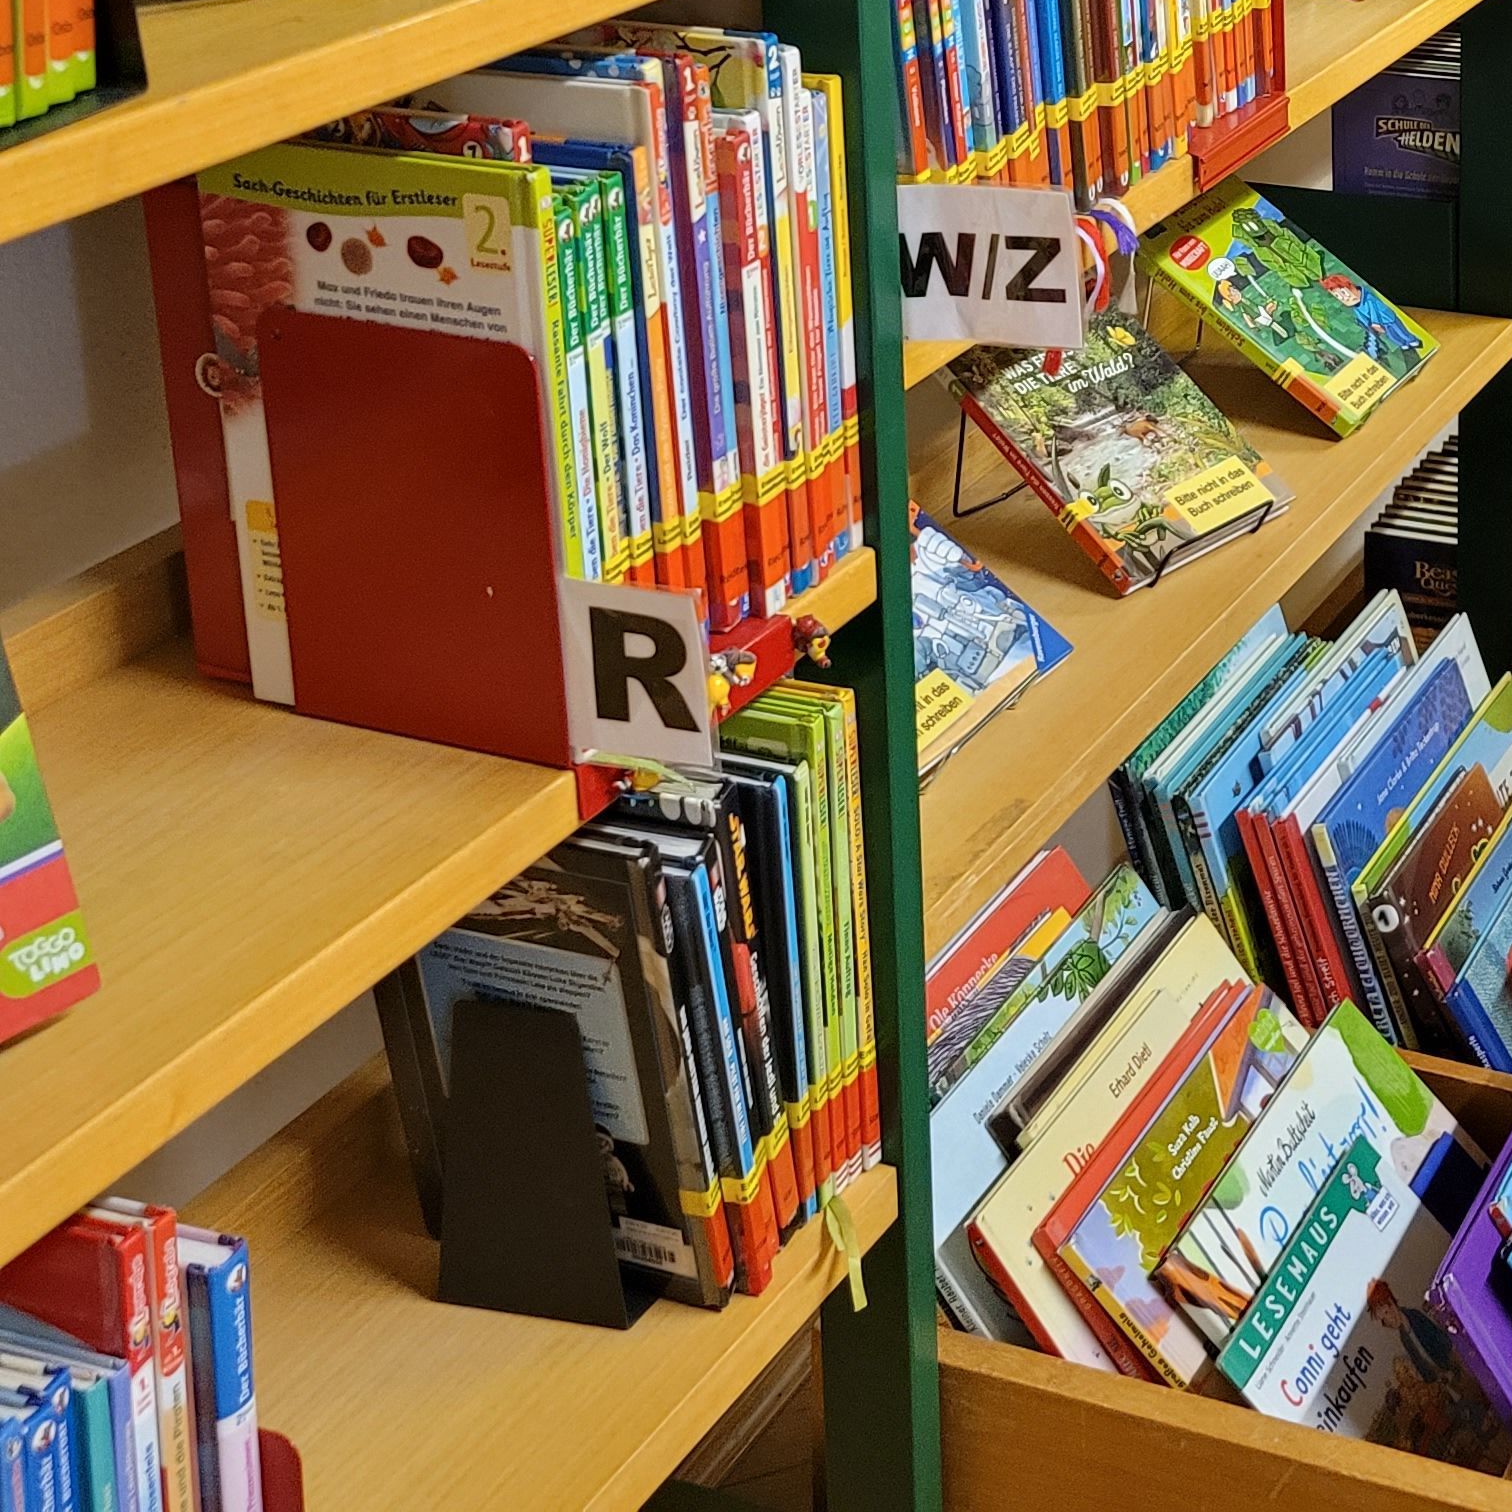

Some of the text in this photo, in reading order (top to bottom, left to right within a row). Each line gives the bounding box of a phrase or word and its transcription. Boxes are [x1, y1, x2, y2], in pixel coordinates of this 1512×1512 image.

[1378, 119, 1418, 133] SCHULE
[1398, 131, 1460, 155] HELDEN
[232, 173, 458, 207] Sach-Geschichten für Erstleser
[742, 170, 753, 235] Bücherbär
[474, 205, 508, 257] 2.
[584, 232, 600, 328] Der Bücherbär
[614, 216, 629, 310] Der Bücherbär
[899, 231, 1067, 303] W/Z
[317, 280, 501, 318] Max und Frieda trauen ihren Augen
[345, 300, 362, 313] Sie
[365, 305, 396, 319] sehen
[399, 308, 428, 322] einen
[430, 311, 485, 331] Menschen
[487, 323, 507, 334] von
[563, 248, 579, 347] Der Bücherbär
[1212, 316, 1247, 349] Schleim
[1005, 360, 1038, 382] WAS
[1014, 376, 1041, 395] DIE
[1068, 376, 1090, 394] im
[1083, 352, 1135, 386] Wald?
[1338, 388, 1352, 401] Bitte
[1351, 378, 1364, 391] nicht
[1367, 365, 1379, 375] das
[626, 372, 639, 429] Kaninchen
[1350, 375, 1388, 409] Buch schreiben
[599, 421, 612, 474] Der Wolf
[630, 433, 641, 456] Das
[581, 477, 592, 497] Die
[632, 464, 643, 493] Tiere
[1174, 466, 1247, 507] Bitte nicht in das
[565, 492, 577, 539] Körper
[1187, 479, 1255, 519] Buch schreiben
[584, 506, 595, 534] Tiere
[589, 607, 702, 732] R
[932, 681, 950, 698] das
[921, 696, 962, 732] schreiben
[1377, 907, 1390, 926] 1
[8, 927, 75, 972] TOGGO
[30, 942, 85, 982] LINO
[930, 952, 998, 1030] Ole Könnecke
[1109, 1043, 1153, 1098] Erhard Dietl
[1183, 1115, 1200, 1138] Kolb
[1172, 1118, 1219, 1180] Christine Faust
[1239, 1206, 1338, 1360] LESEMAUS
[234, 1297, 251, 1402] Der Bücherbär
[1115, 1309, 1159, 1361] Geheimnis
[1281, 1302, 1353, 1407] Conni geht
